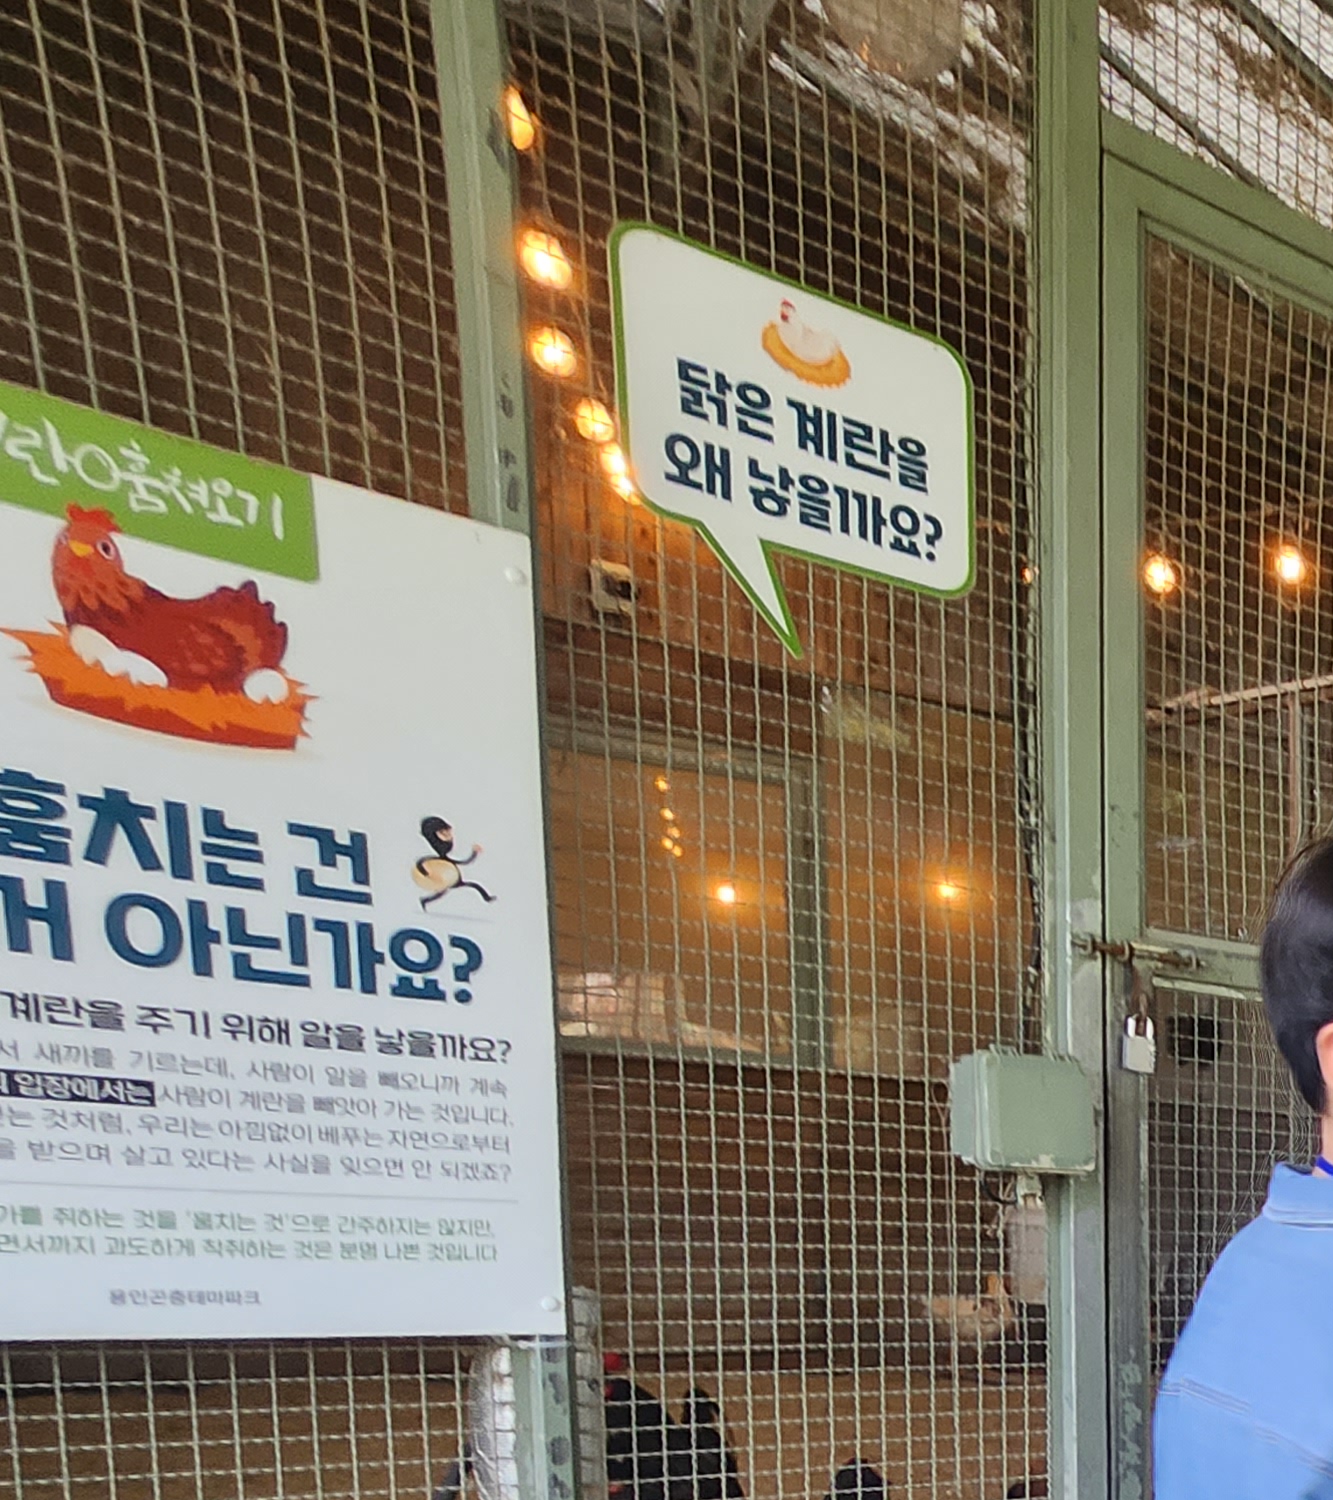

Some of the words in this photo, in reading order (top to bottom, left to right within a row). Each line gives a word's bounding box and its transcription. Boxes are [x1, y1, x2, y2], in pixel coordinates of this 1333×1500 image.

[0, 411, 68, 487] 란
[676, 357, 774, 443] 닭은
[786, 397, 929, 495] 계란을
[664, 433, 732, 501] 왜
[748, 457, 942, 561] 낳을까요?
[0, 768, 265, 891] 훔치는
[287, 821, 374, 906] 건
[103, 892, 484, 1004] 아닌가요?
[0, 990, 125, 1032] 계란을
[135, 1004, 211, 1039] 주기
[221, 1012, 292, 1047] 위해
[300, 1020, 366, 1053] 알을
[375, 1026, 512, 1063] 낳을까요?
[13, 1073, 151, 1104] 입장에서는
[159, 1086, 230, 1109] 사람이
[239, 1089, 306, 1114] 계란을
[383, 1100, 424, 1121] 가는
[432, 1103, 514, 1127] 것입니다.
[34, 1042, 115, 1070] 새끼를
[129, 1050, 235, 1080] 기르는데,
[249, 1059, 314, 1085] 사람이
[325, 1066, 367, 1089] 알을
[469, 1077, 507, 1098] 계속
[0, 1106, 34, 1128] 는
[42, 1107, 132, 1135] 것처럼,
[138, 1113, 212, 1139] 우리는
[218, 1118, 312, 1145] 아낌없이
[318, 1126, 383, 1148] 베푸는
[389, 1129, 510, 1154] 자연으로부터
[27, 1140, 111, 1164] 받으며
[124, 1145, 172, 1166] 살고
[182, 1148, 252, 1170] 있다는
[264, 1152, 331, 1176] 사실을
[412, 1160, 432, 1180] 안
[53, 1207, 124, 1228] 취하는
[104, 1236, 195, 1258] 과도하게
